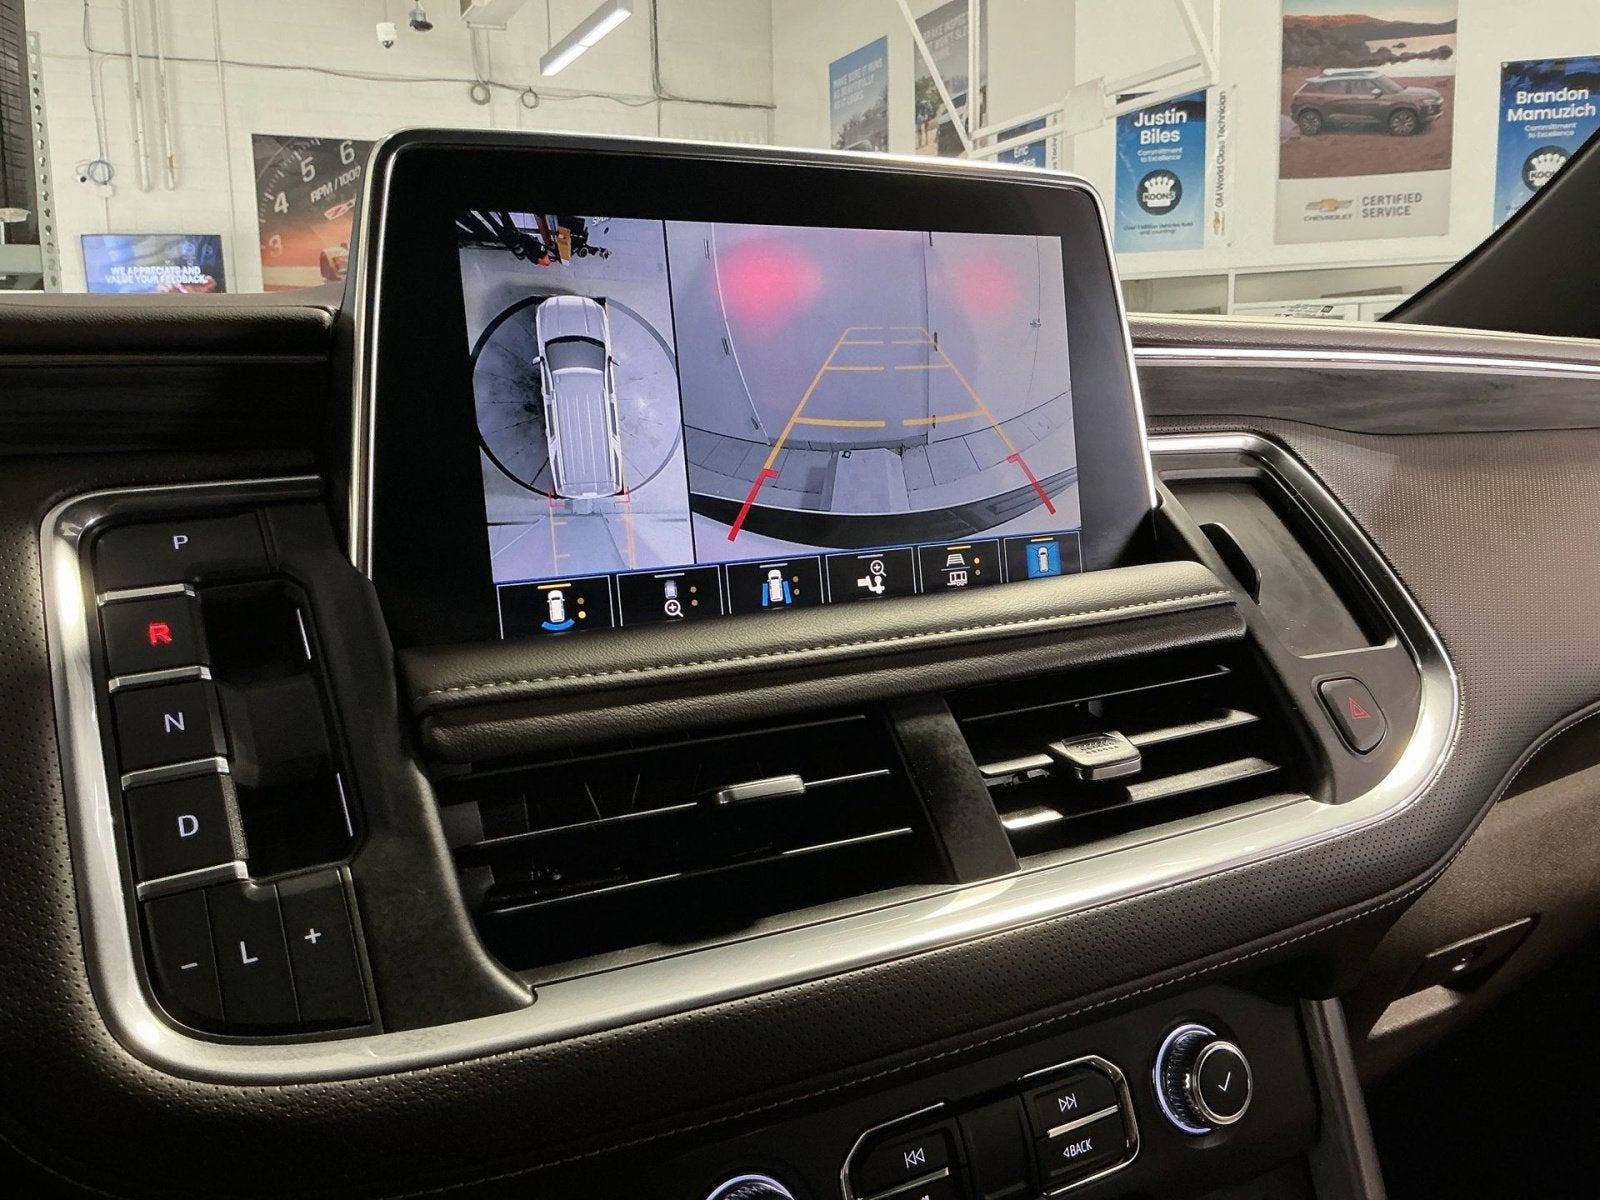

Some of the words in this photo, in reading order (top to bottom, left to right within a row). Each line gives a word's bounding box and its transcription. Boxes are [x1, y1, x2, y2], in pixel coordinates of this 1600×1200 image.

[1515, 87, 1589, 104] Brandon
[1134, 108, 1187, 127] Justin
[1216, 91, 1227, 139] Technician
[1507, 103, 1596, 122] Mamuzich
[1140, 128, 1181, 145] Biles
[1524, 122, 1577, 132] Commitment
[1536, 130, 1575, 138] Excellence
[340, 140, 355, 166] 6
[1137, 147, 1183, 157] Commitment
[1148, 154, 1182, 162] Excellence
[1216, 140, 1226, 165] Class
[300, 156, 316, 183] 5
[1216, 166, 1225, 190] World
[310, 181, 333, 203] RPM
[1143, 191, 1176, 201] KOONS
[1215, 190, 1225, 208] GM
[1362, 192, 1423, 206] CERTIFIED
[274, 192, 290, 214] 4
[1361, 205, 1411, 218] SERVICE
[1304, 213, 1353, 222] CHEVROLET
[269, 234, 282, 257] 3
[110, 266, 125, 275] WE
[181, 266, 201, 275] AND
[136, 275, 159, 284] YOUR
[173, 535, 189, 550] P
[149, 622, 173, 646] R
[164, 712, 185, 732] N
[178, 814, 199, 838] D
[240, 941, 258, 964] L
[1069, 1138, 1093, 1157] BACK
